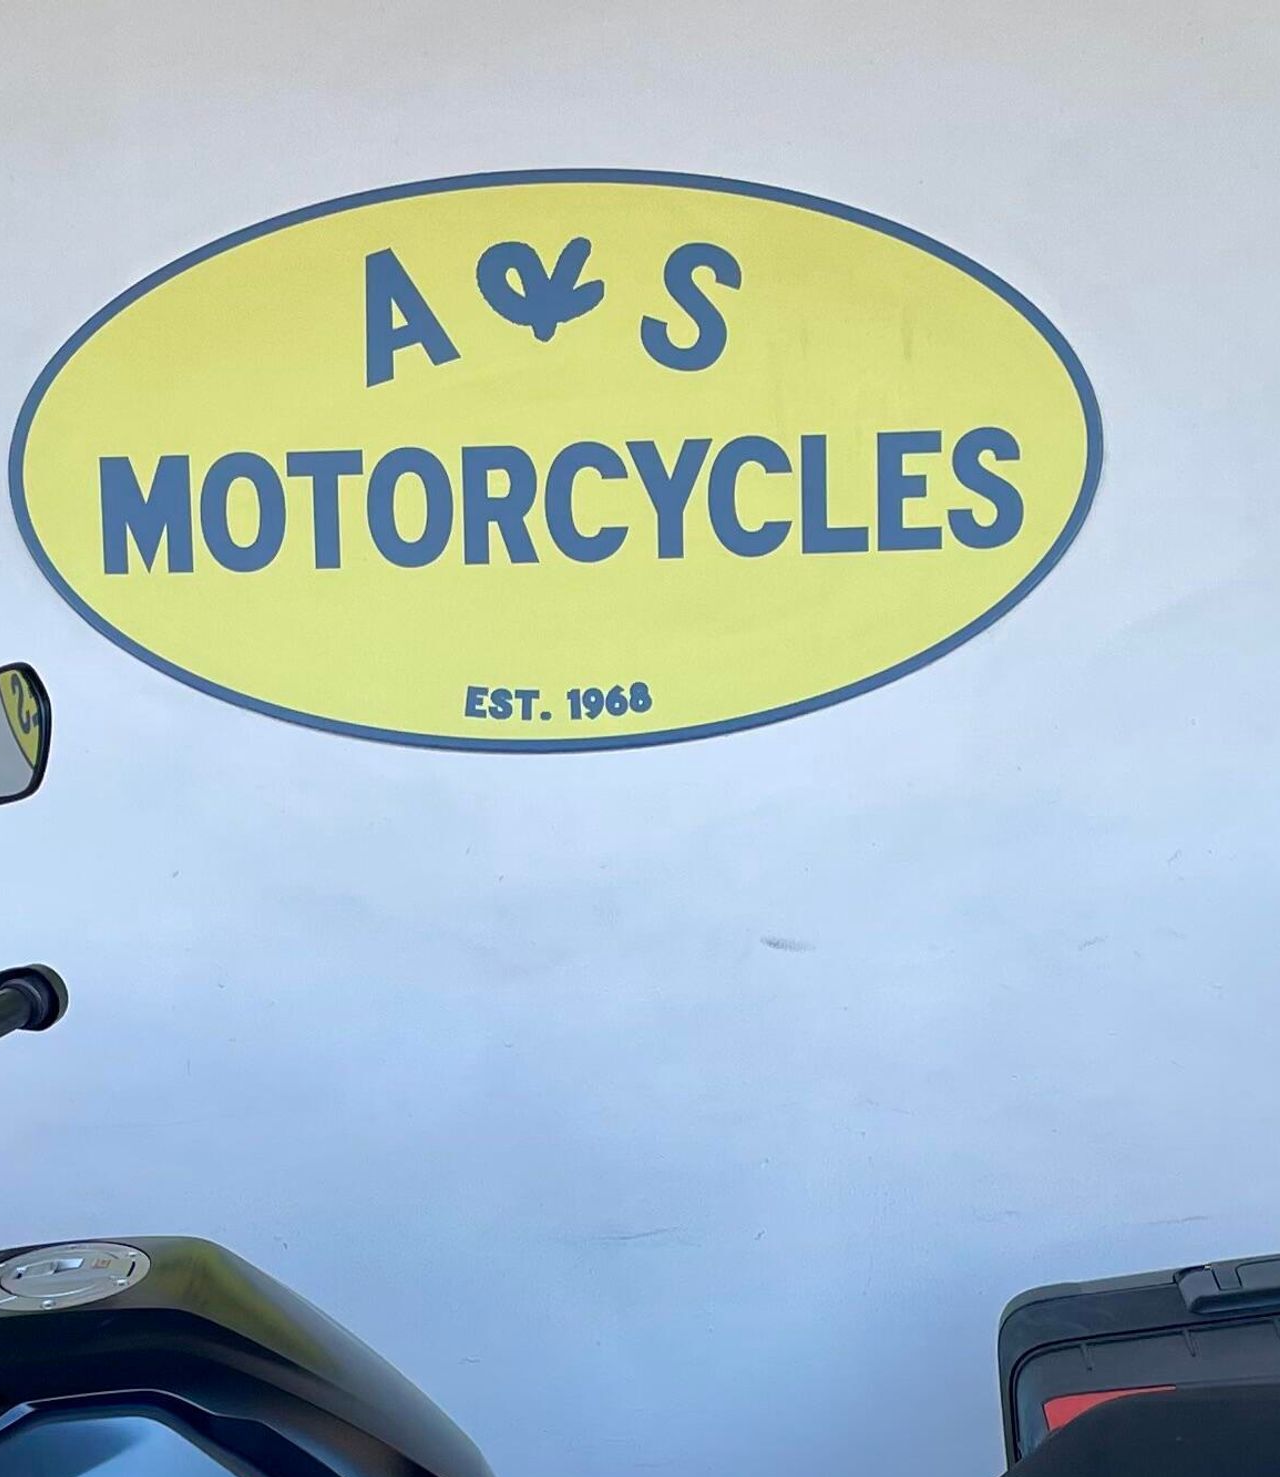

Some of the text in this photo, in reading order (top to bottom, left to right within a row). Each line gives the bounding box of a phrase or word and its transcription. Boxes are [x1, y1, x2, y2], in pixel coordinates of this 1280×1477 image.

[365, 248, 461, 388] A
[640, 242, 742, 372] S
[99, 427, 1024, 575] MOTORCYCLES
[465, 681, 652, 720] EST. 1968
